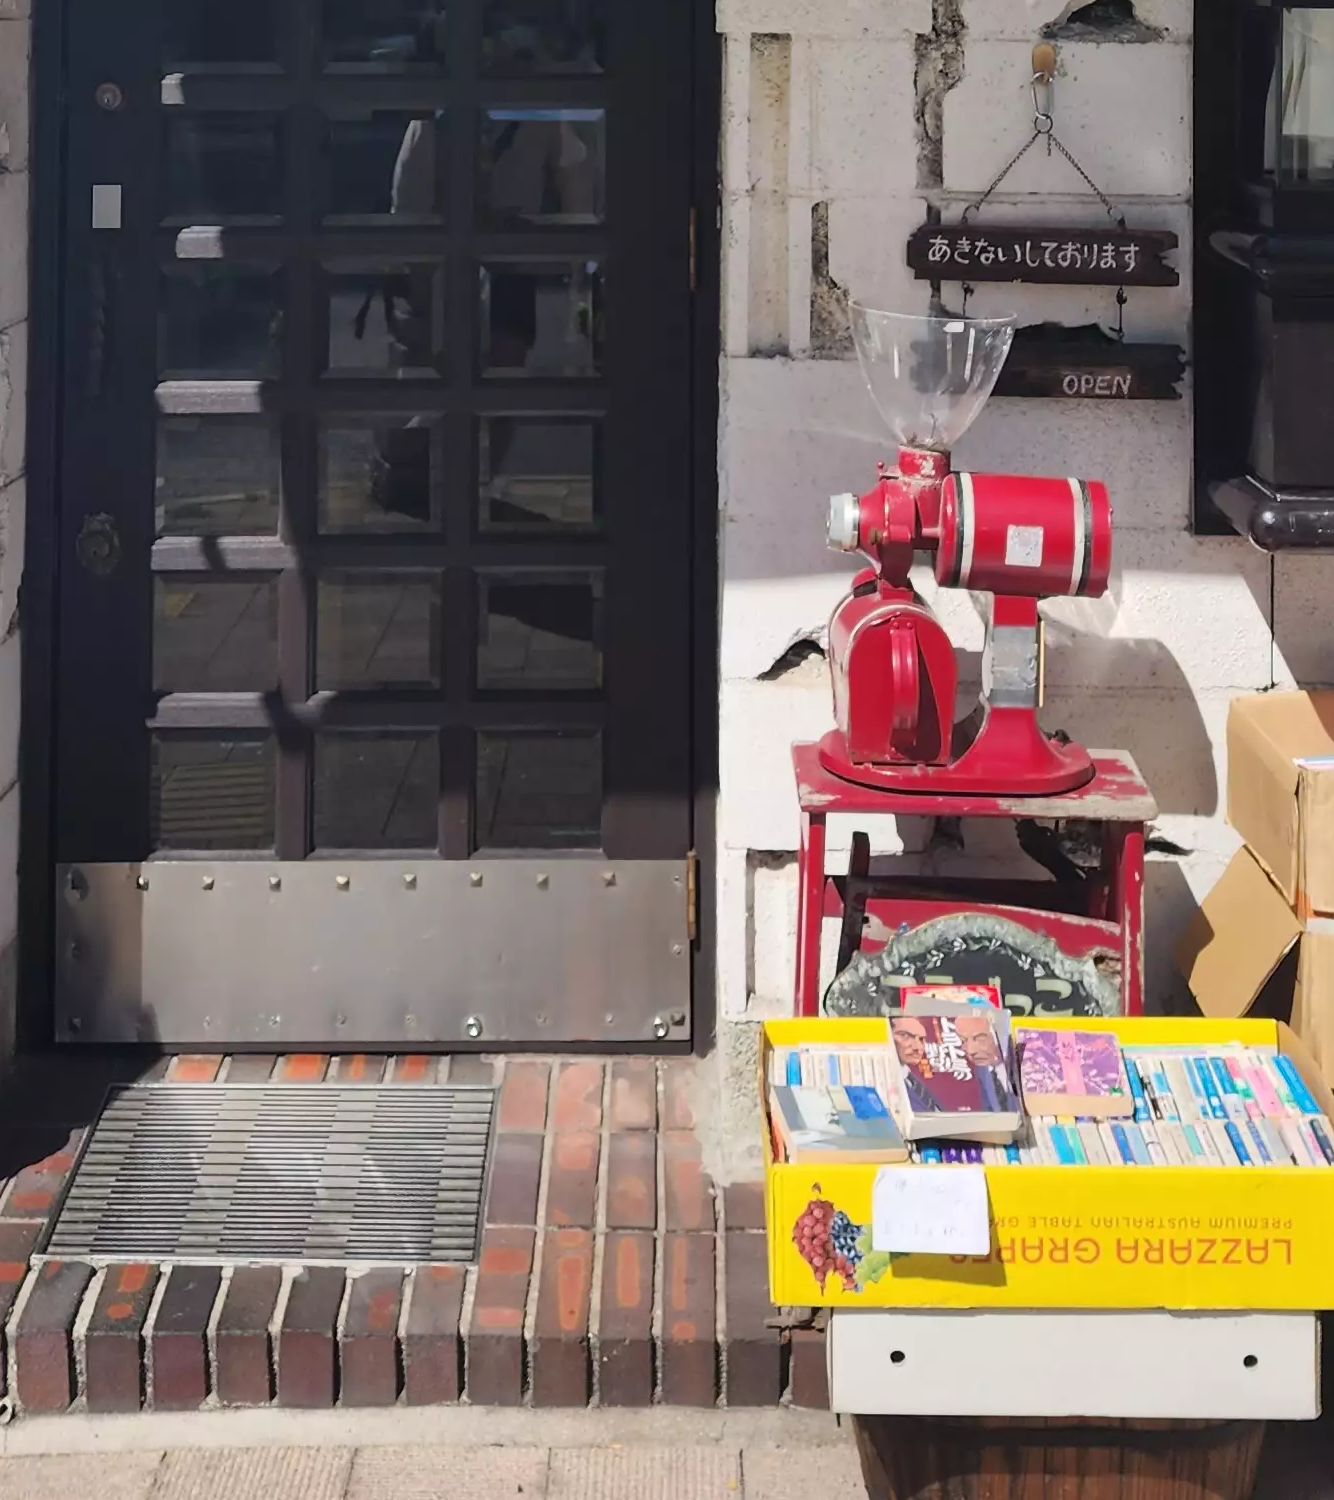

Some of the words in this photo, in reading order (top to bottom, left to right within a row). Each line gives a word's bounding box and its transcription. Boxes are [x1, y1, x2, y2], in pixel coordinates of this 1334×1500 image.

[927, 233, 1140, 273] あきないしております
[1062, 373, 1132, 396] OPEN
[1028, 1216, 1083, 1230] TABLE
[1089, 1216, 1202, 1230] AUSTRALIAN
[1208, 1216, 1293, 1230] PREMIUM
[1116, 1237, 1293, 1266] LAZZARA
